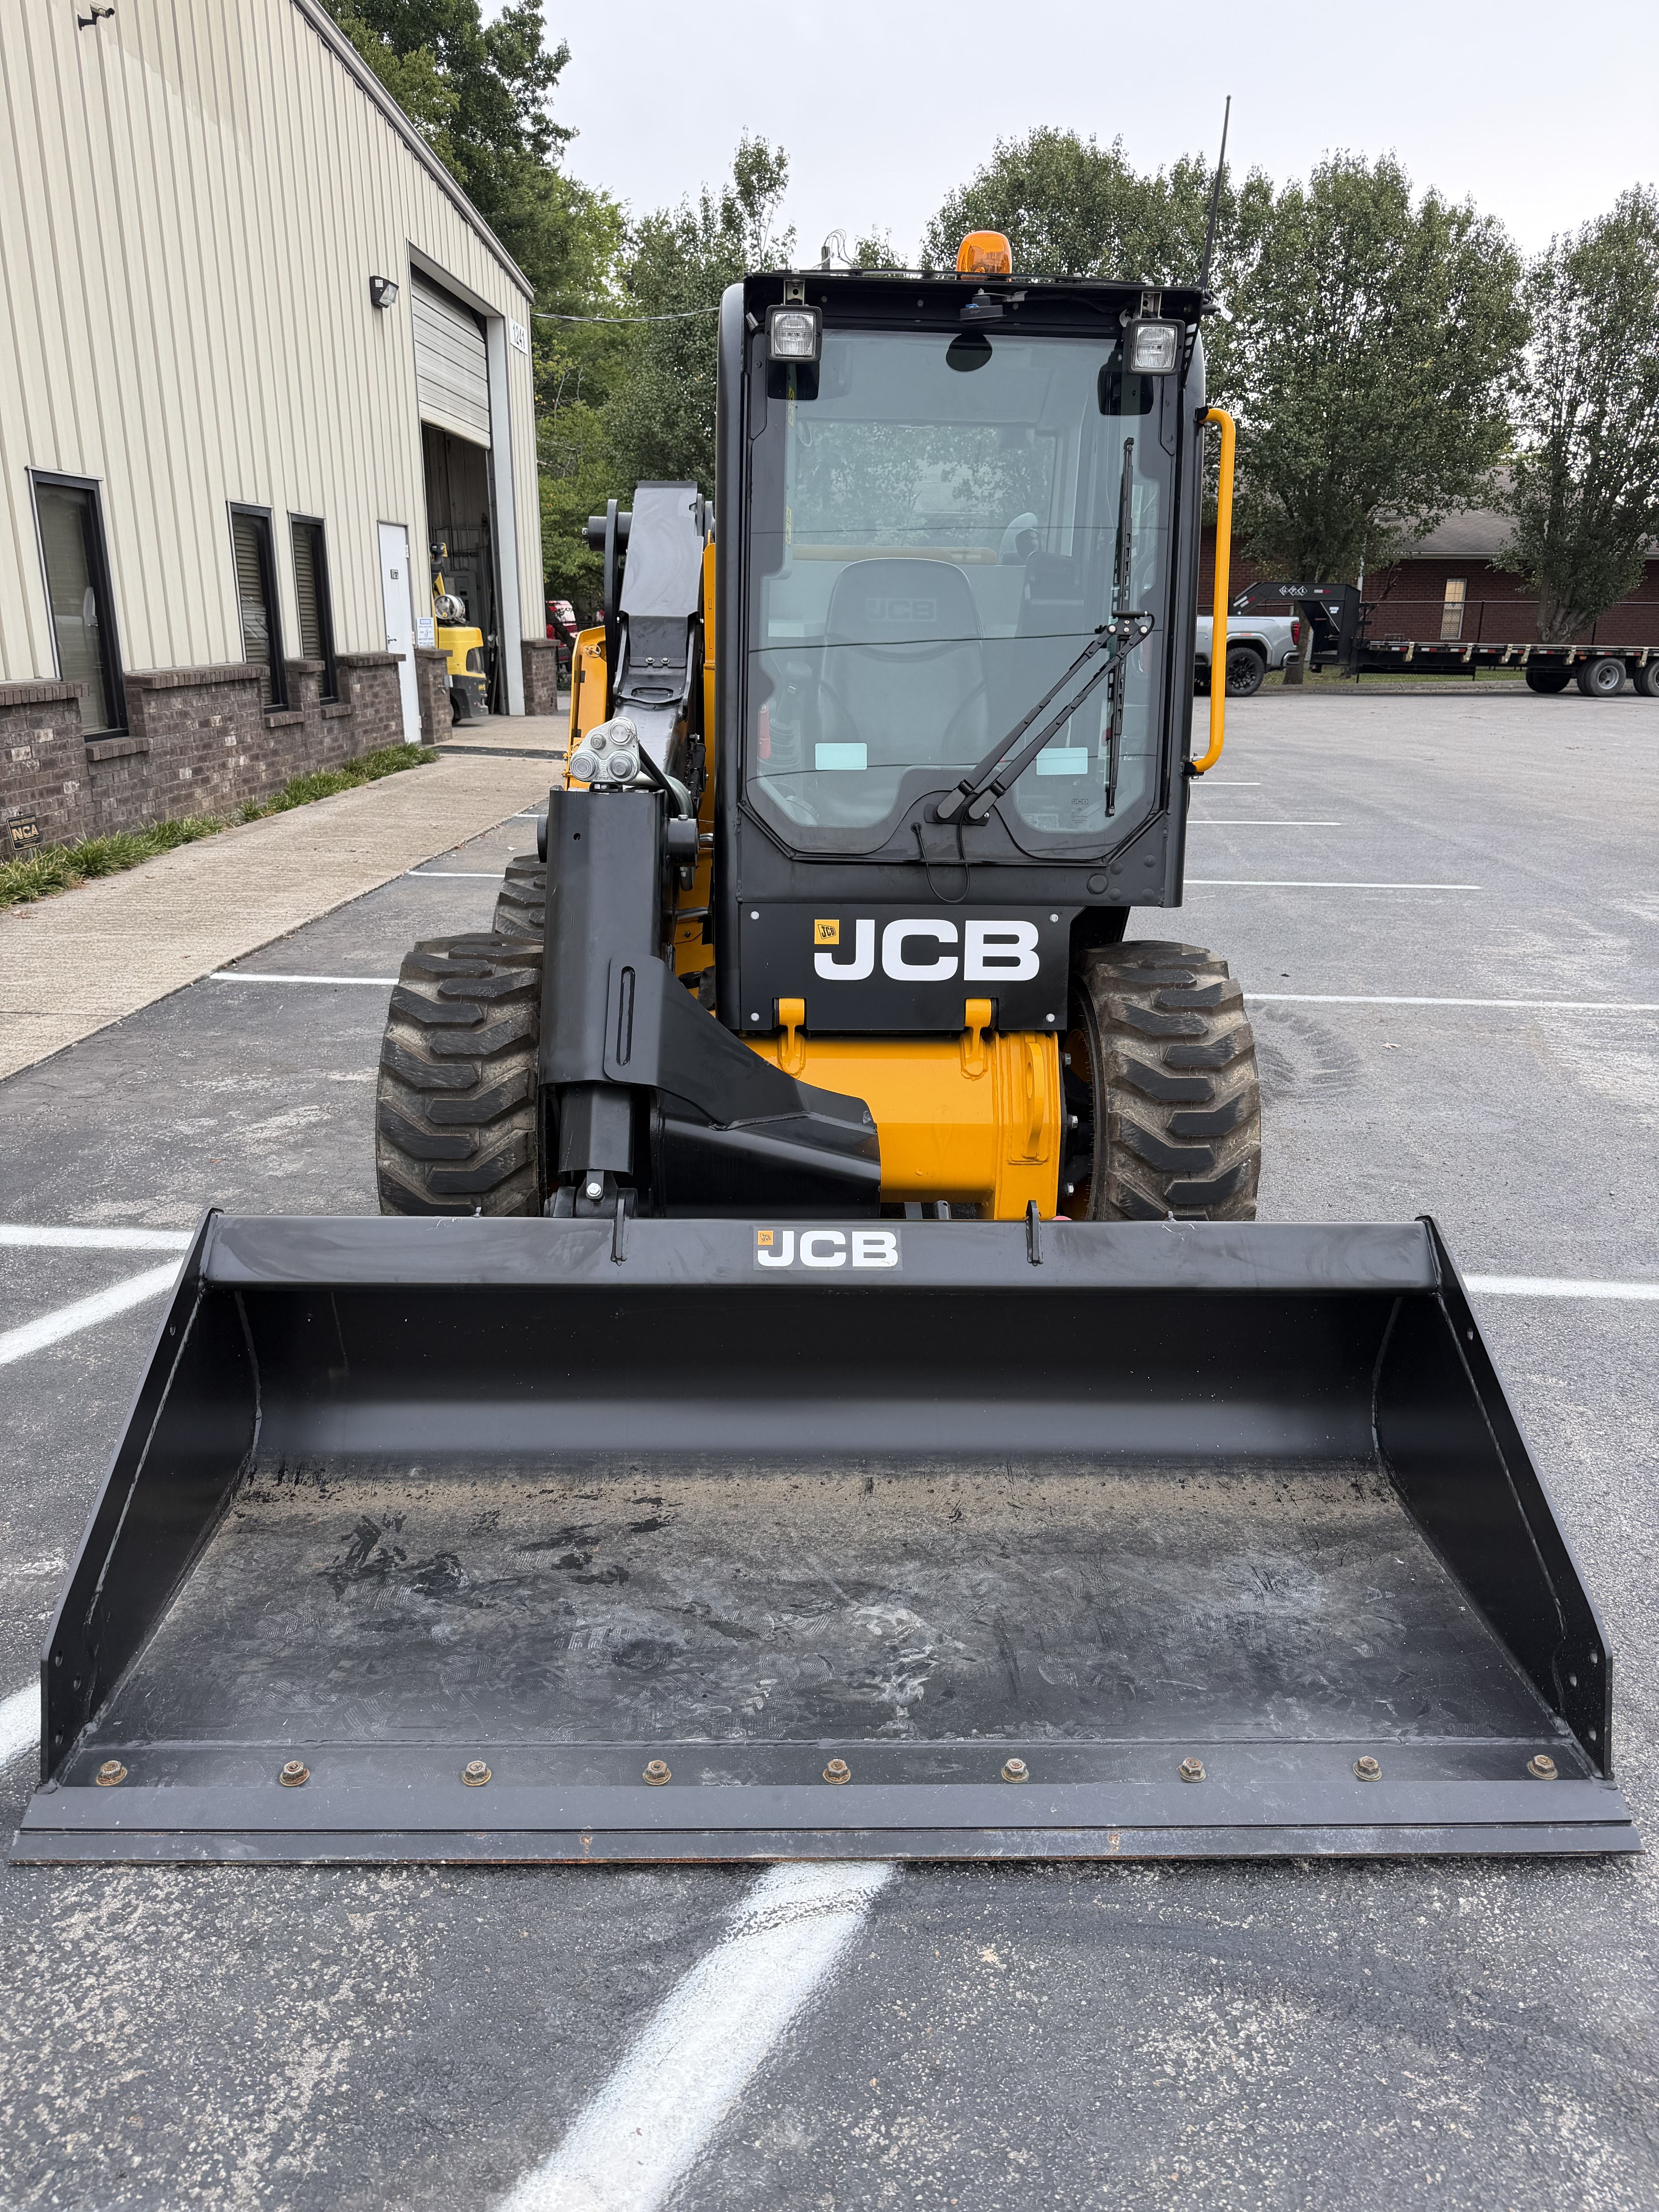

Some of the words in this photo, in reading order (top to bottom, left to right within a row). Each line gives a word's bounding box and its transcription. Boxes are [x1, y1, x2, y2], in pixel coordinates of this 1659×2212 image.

[513, 324, 525, 349] 1241
[868, 600, 934, 620] JCB
[12, 824, 39, 841] NCA
[821, 926, 835, 938] JCB
[814, 919, 1039, 981] JCB
[757, 1230, 898, 1267] JCB
